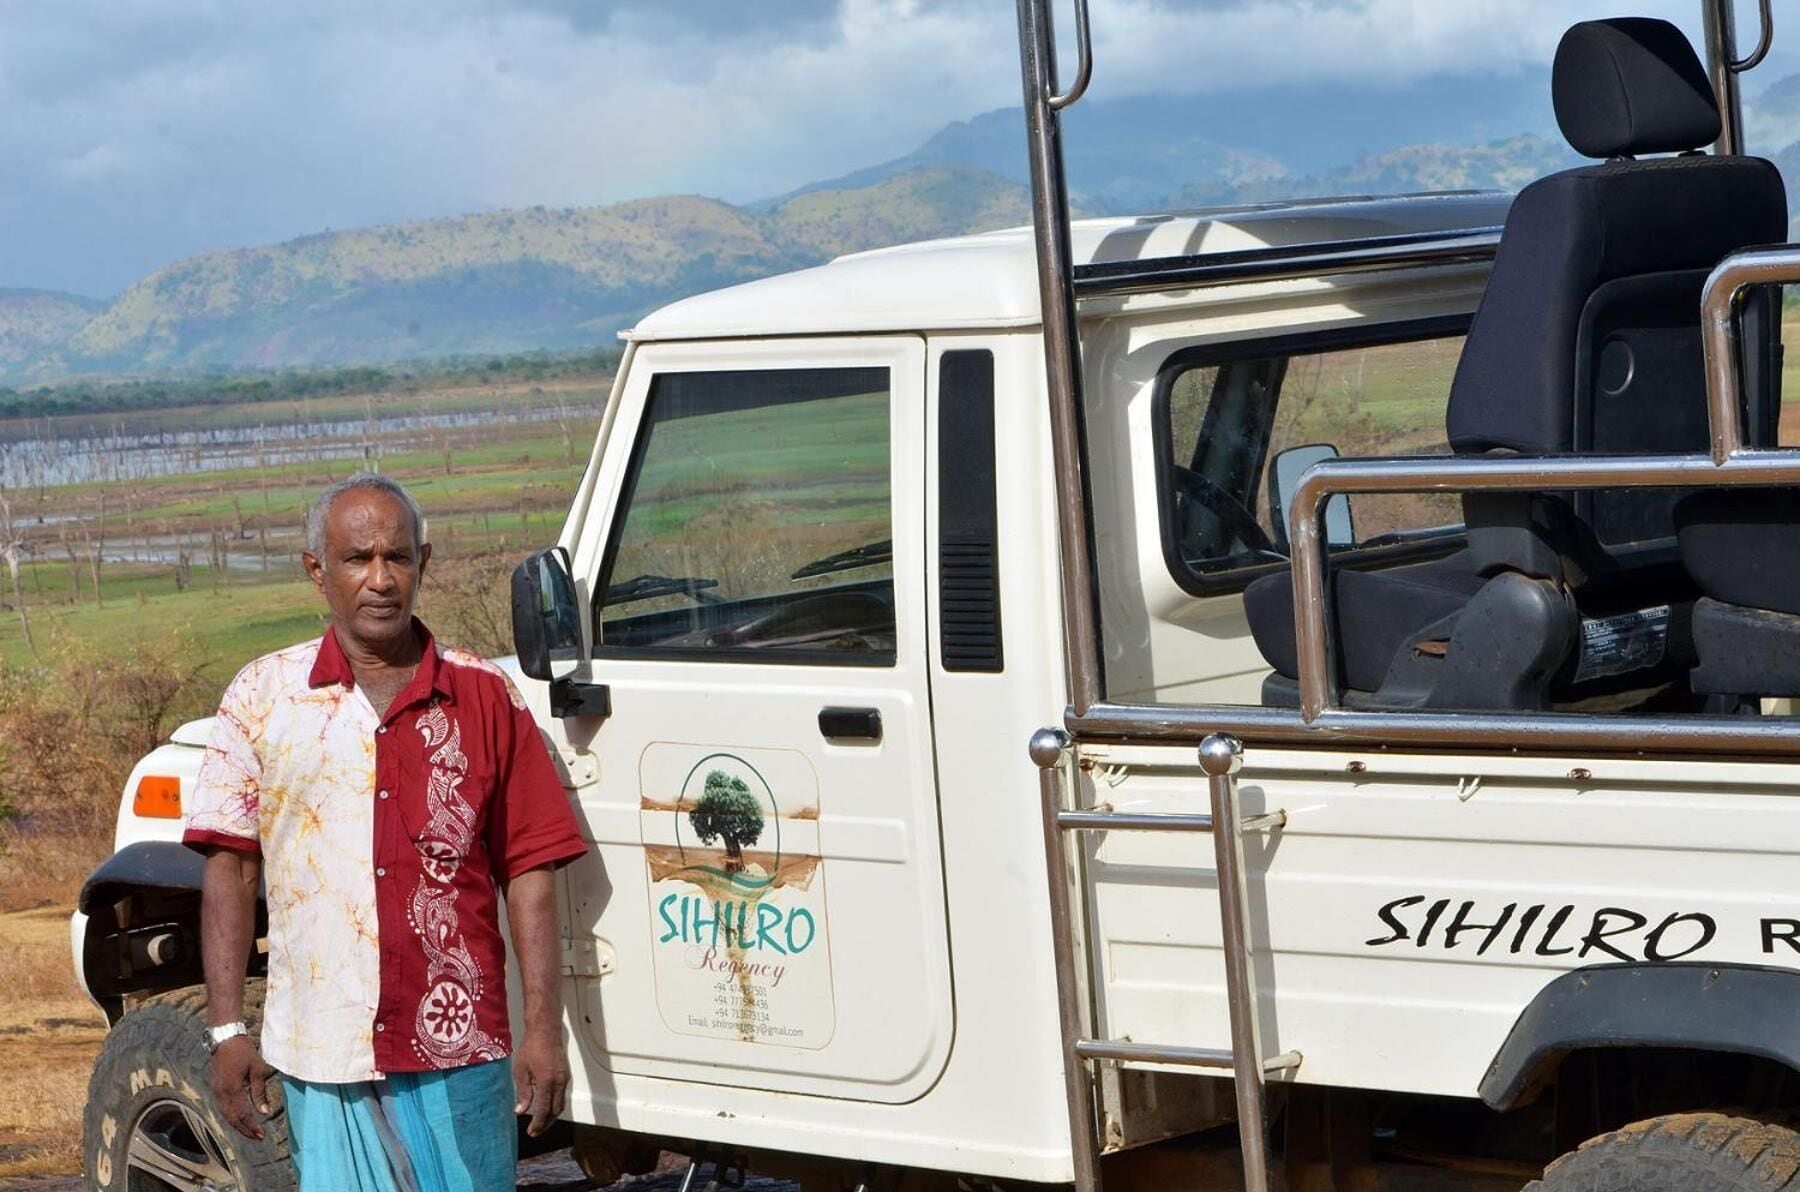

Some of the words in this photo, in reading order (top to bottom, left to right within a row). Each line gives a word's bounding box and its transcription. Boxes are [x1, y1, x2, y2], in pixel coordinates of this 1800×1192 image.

[658, 894, 816, 956] SIHILRO
[1365, 895, 1717, 961] SIHILRO
[684, 945, 786, 988] Regency
